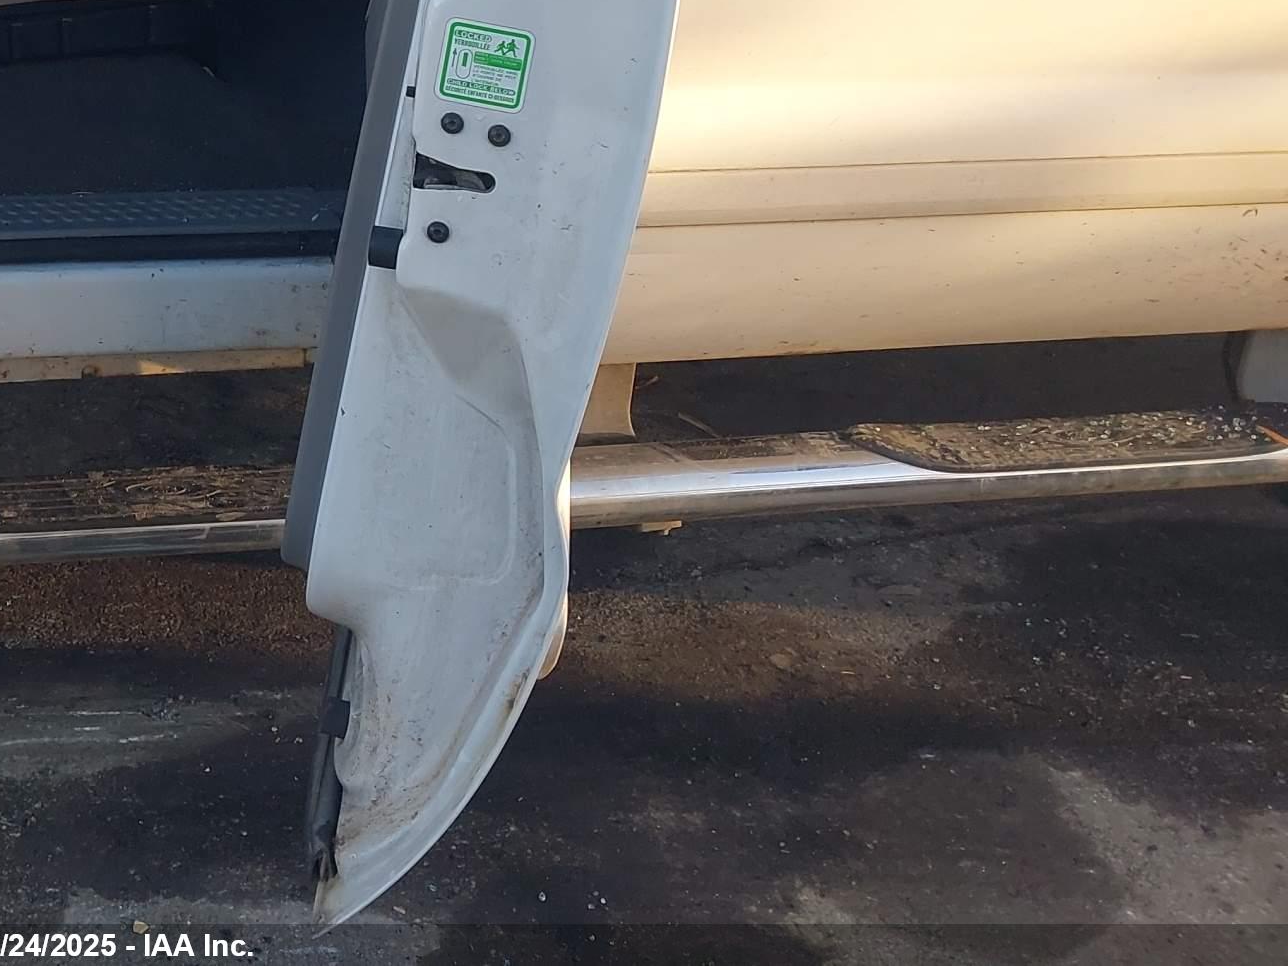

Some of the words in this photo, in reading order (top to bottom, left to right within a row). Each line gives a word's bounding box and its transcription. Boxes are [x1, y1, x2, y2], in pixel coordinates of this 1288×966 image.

[455, 30, 491, 42] LOCKED
[447, 79, 468, 88] CHILD
[469, 82, 490, 91] LOCK
[491, 86, 516, 96] BELOW
